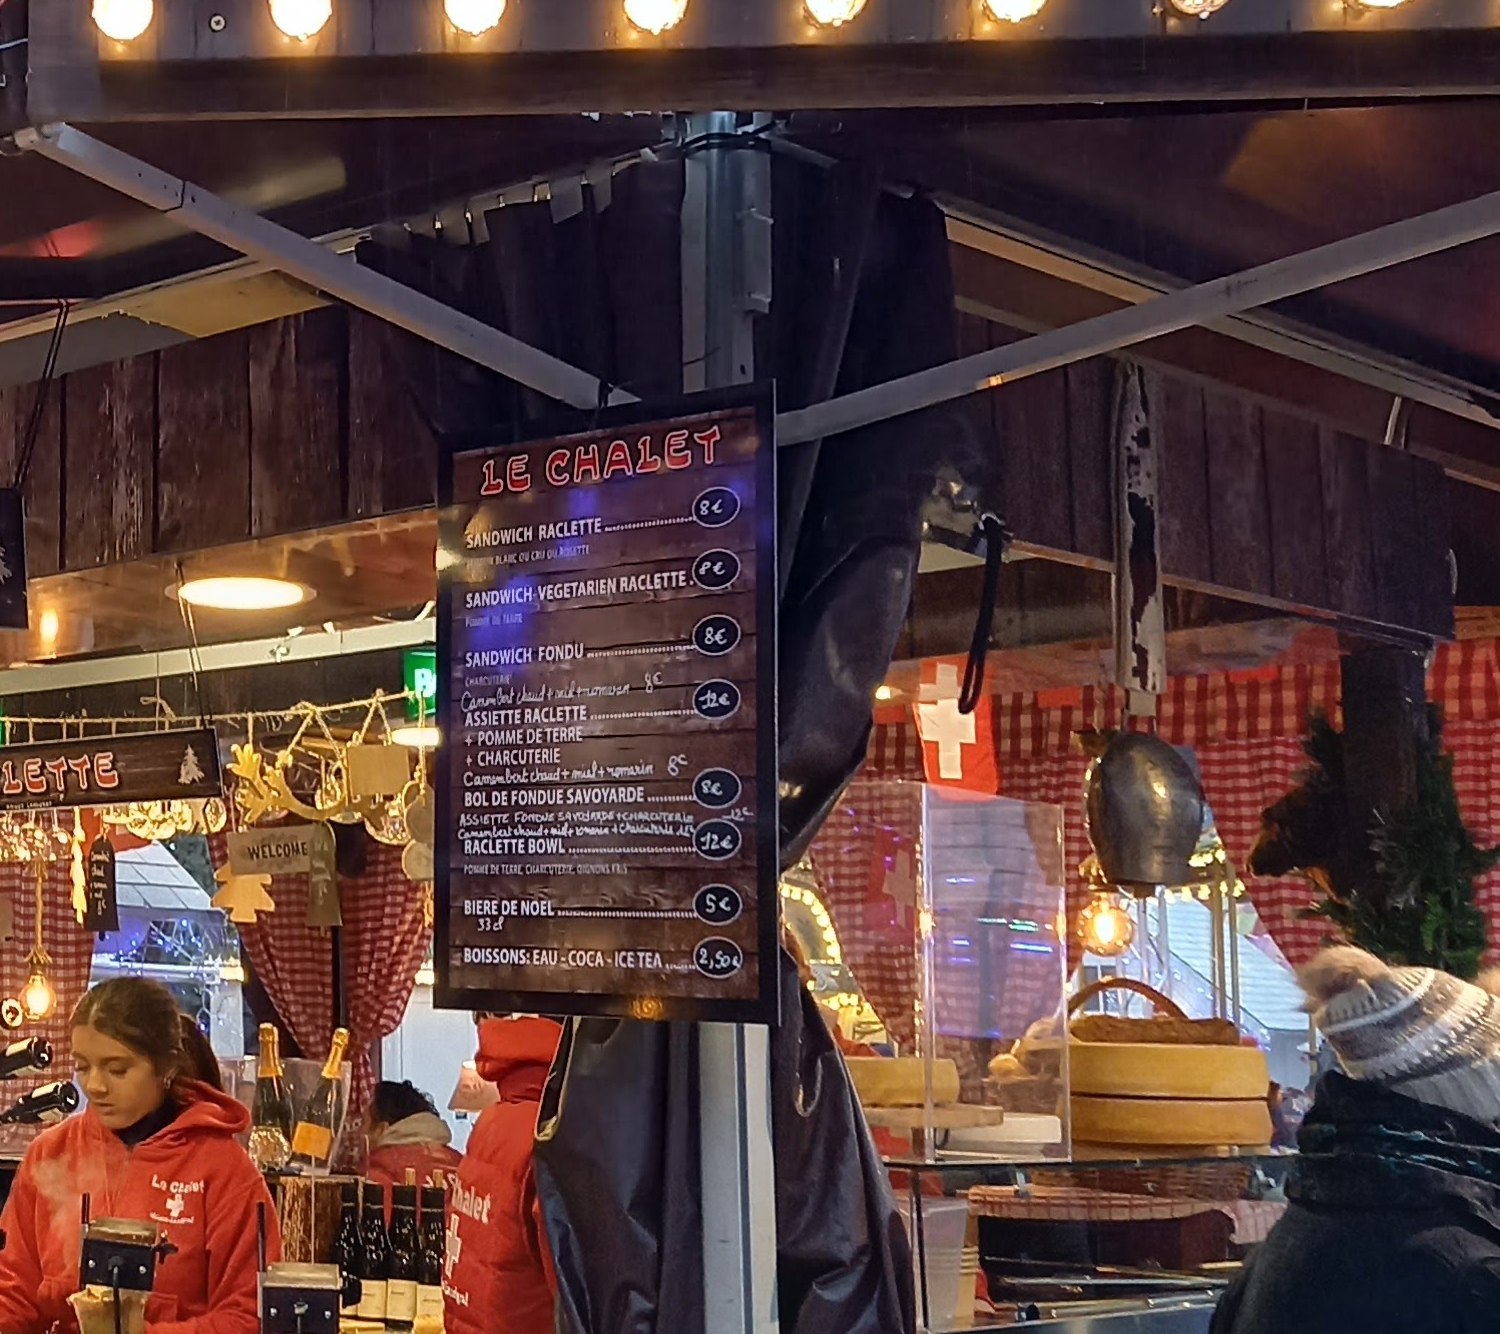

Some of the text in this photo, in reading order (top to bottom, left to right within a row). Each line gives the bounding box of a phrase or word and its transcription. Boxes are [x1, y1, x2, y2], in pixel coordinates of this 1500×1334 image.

[481, 426, 721, 496] LE CHALET
[466, 525, 533, 549] SANDWICH
[538, 518, 602, 541] RACLETTE
[465, 586, 533, 609] SANDWICH
[538, 577, 617, 602] VEGETARIEN
[619, 570, 687, 593] RACLETTE
[465, 626, 728, 668] SANDWICH FONDU 8€
[465, 709, 522, 728] ASSIETTE
[524, 705, 588, 725] RACLETTE
[477, 729, 524, 747] POMME
[526, 728, 545, 745] DE
[543, 726, 584, 744] TERRE
[477, 747, 561, 767] CHARCUTERIE
[464, 791, 490, 807] BOL
[491, 790, 509, 807] DE
[511, 789, 564, 806] FONDUE
[566, 787, 645, 805] SAVOYARDE
[247, 841, 308, 863] WELCOME
[464, 832, 733, 855] RACLETTE BOWL 12€
[464, 893, 731, 916] BIERE DE NOEL 5€
[464, 948, 531, 965] BOISSONS:
[533, 949, 558, 965] EAU
[568, 950, 604, 967] COCA
[614, 951, 635, 968] ICE
[637, 952, 663, 968] TEA
